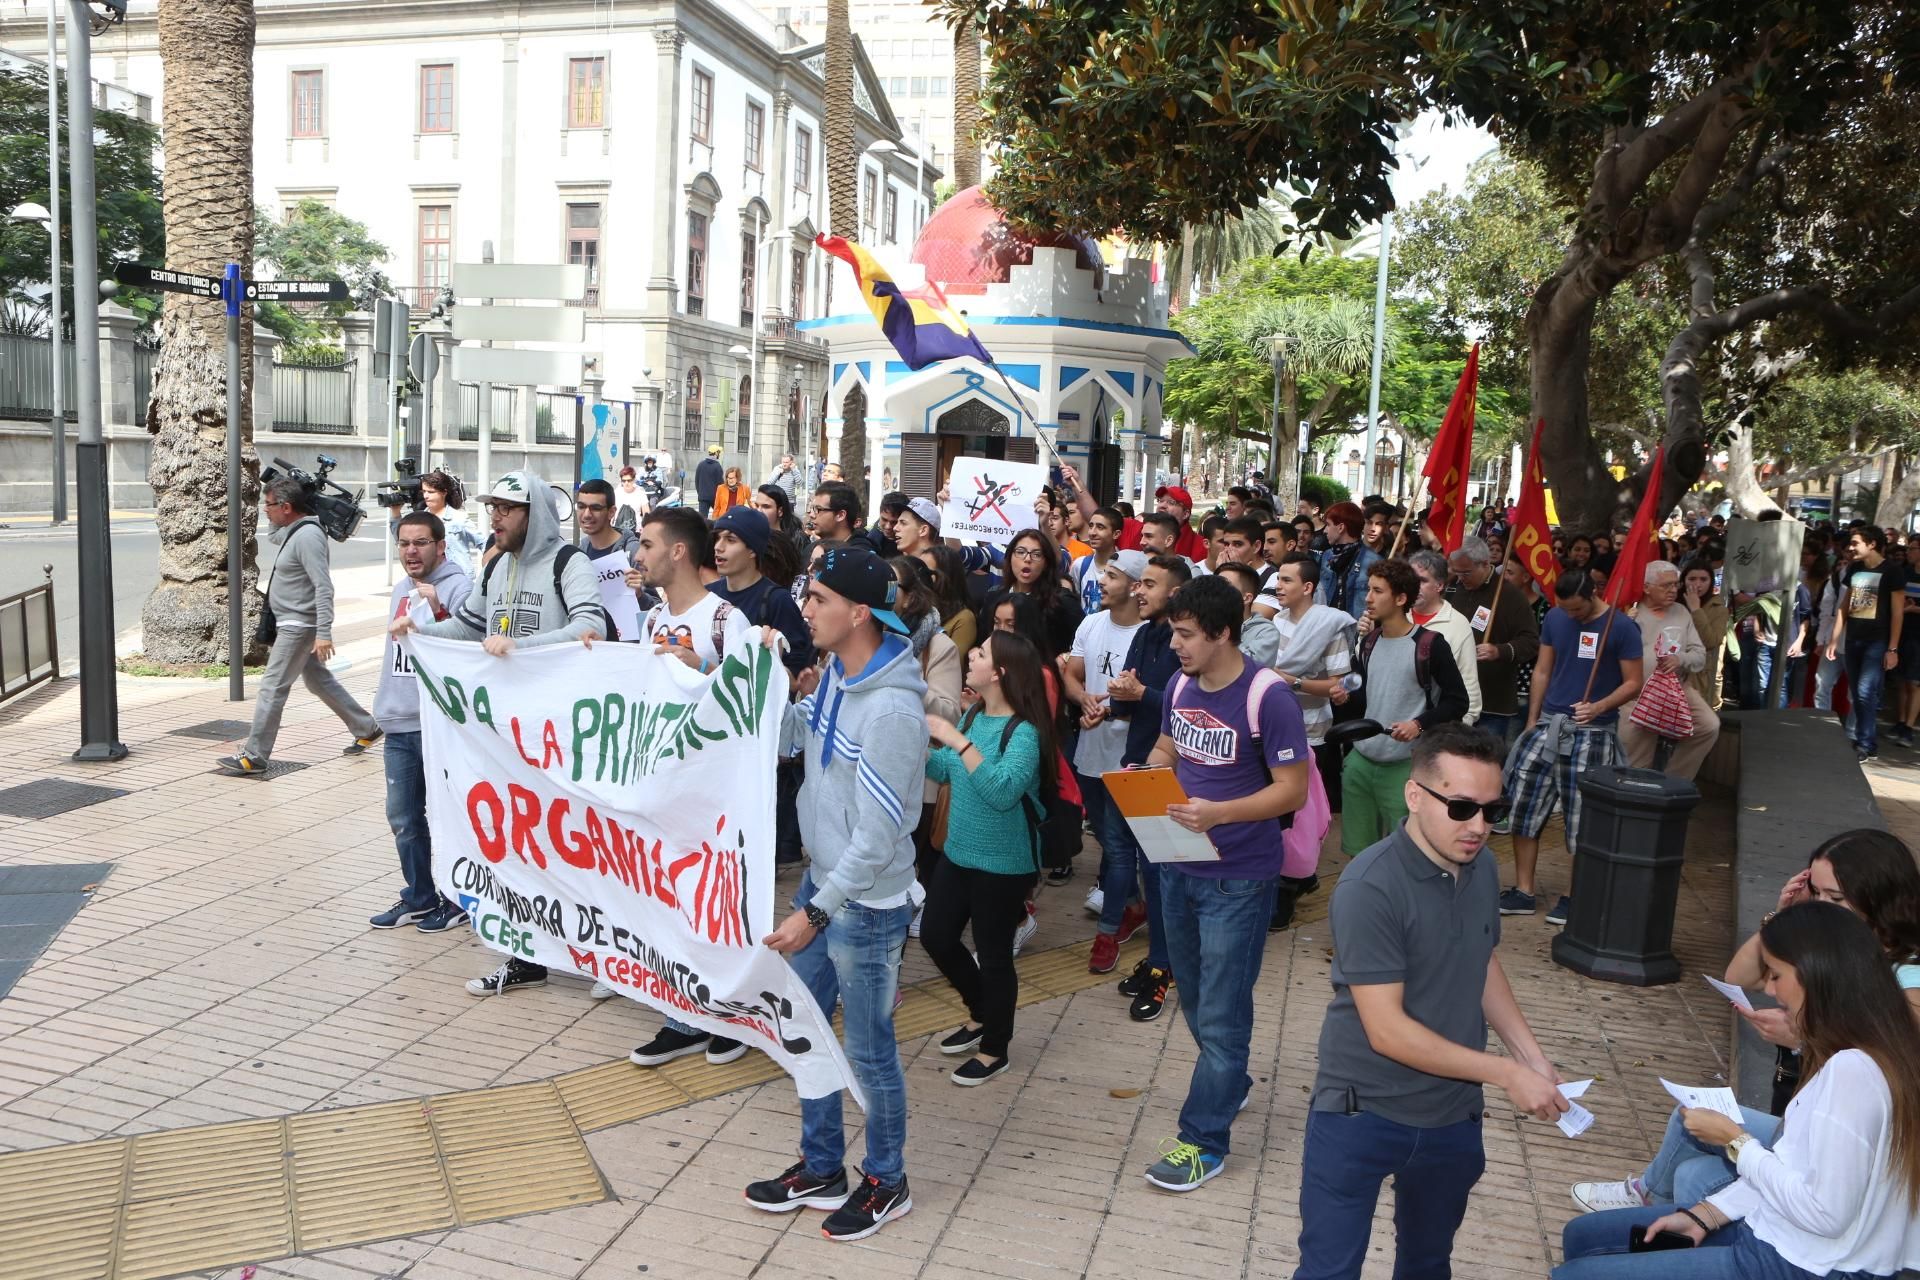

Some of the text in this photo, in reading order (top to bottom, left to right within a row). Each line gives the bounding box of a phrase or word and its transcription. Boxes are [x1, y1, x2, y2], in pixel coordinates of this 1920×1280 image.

[150, 269, 177, 283] CENTRO
[289, 283, 298, 292] DE
[300, 282, 330, 293] GUAGUAS
[993, 527, 1009, 535] LOS
[395, 643, 417, 674] AL
[510, 717, 563, 770] LA
[575, 903, 608, 946] DE
